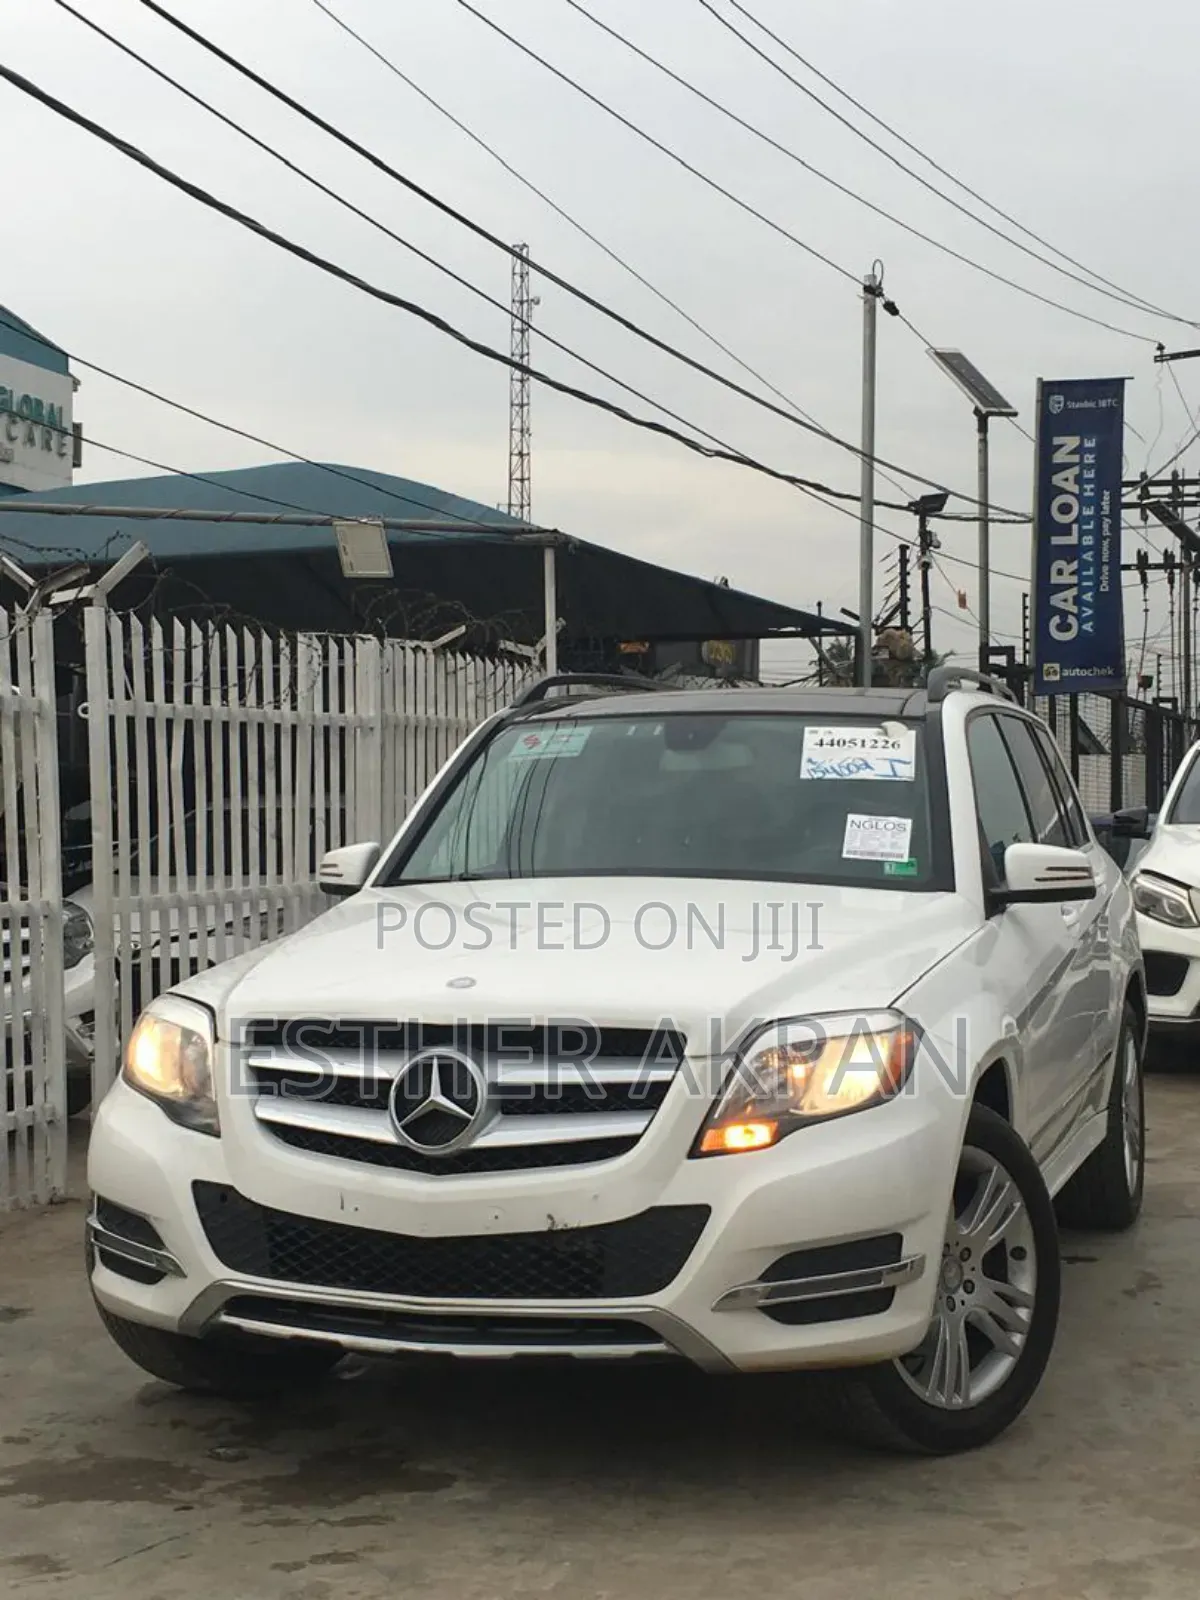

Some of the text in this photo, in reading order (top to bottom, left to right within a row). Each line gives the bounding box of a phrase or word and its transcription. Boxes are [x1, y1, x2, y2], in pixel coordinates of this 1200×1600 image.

[1100, 489, 1111, 515] later
[1081, 437, 1096, 632] AVAILABLE HERE
[1101, 517, 1112, 536] pay
[1049, 435, 1080, 642] CAR LOAN
[1100, 564, 1109, 592] Drive
[1061, 666, 1116, 677] autochek
[813, 737, 901, 750] 44051226
[849, 819, 907, 832] NGLOS
